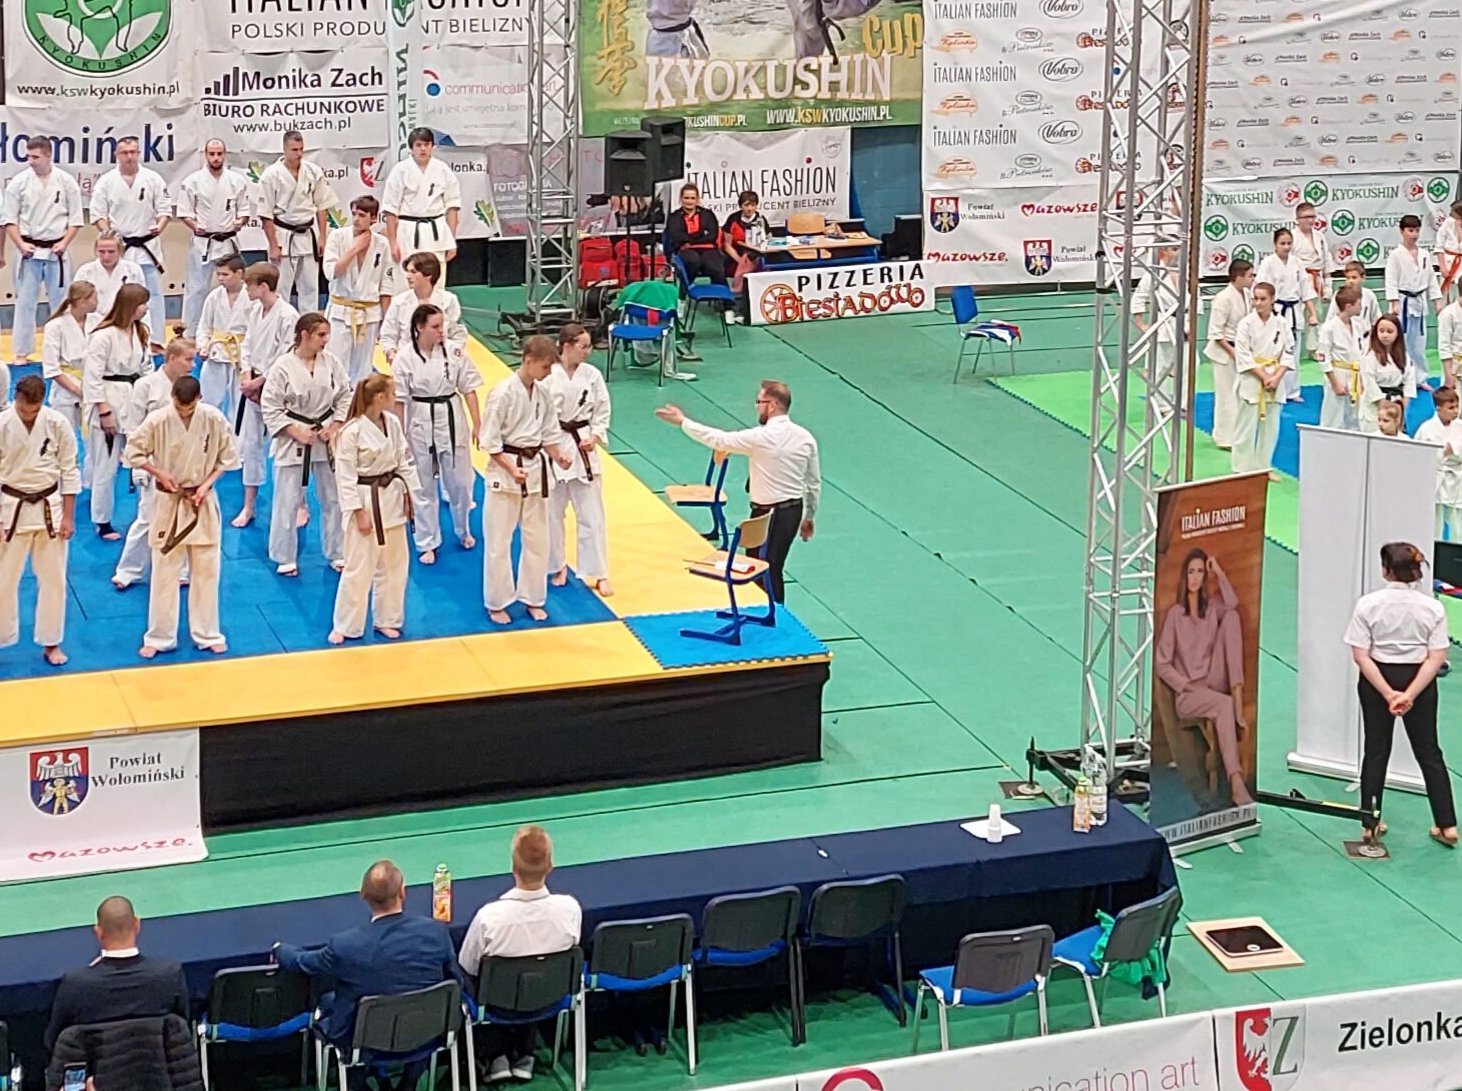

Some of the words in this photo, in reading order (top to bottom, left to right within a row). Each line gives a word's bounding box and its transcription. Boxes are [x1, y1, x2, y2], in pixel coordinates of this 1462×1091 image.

[934, 1, 972, 21] ITALIAN
[231, 22, 305, 40] POLSKI
[39, 32, 162, 71] KYOKUSHIN
[241, 70, 322, 92] Monika
[329, 65, 385, 88] Zach
[643, 52, 894, 111] KYOKUSHIN
[933, 62, 973, 84] ITALIAN
[974, 60, 1018, 83] FASHION
[17, 80, 180, 101] www.kswkyokushin.pl
[202, 100, 256, 120] BIURO
[260, 97, 386, 119] RACHUNKOWE
[766, 104, 893, 126] WWW.KSWKYOKUSHIN.PL
[232, 116, 352, 135] www.bukzach.pl
[933, 124, 972, 147] ITALIAN
[973, 122, 1018, 146] FASHION
[760, 164, 837, 198] FASHION
[1330, 185, 1400, 201] KYOKUSHIN
[1205, 191, 1274, 207] KYOKUSHIN
[797, 262, 925, 293] PIZZERIA
[1181, 509, 1211, 532] ITALIAN
[1211, 505, 1246, 527] FASHION
[109, 752, 162, 770] Powiat
[90, 765, 186, 789] Wołomiński
[1160, 1056, 1200, 1088] art
